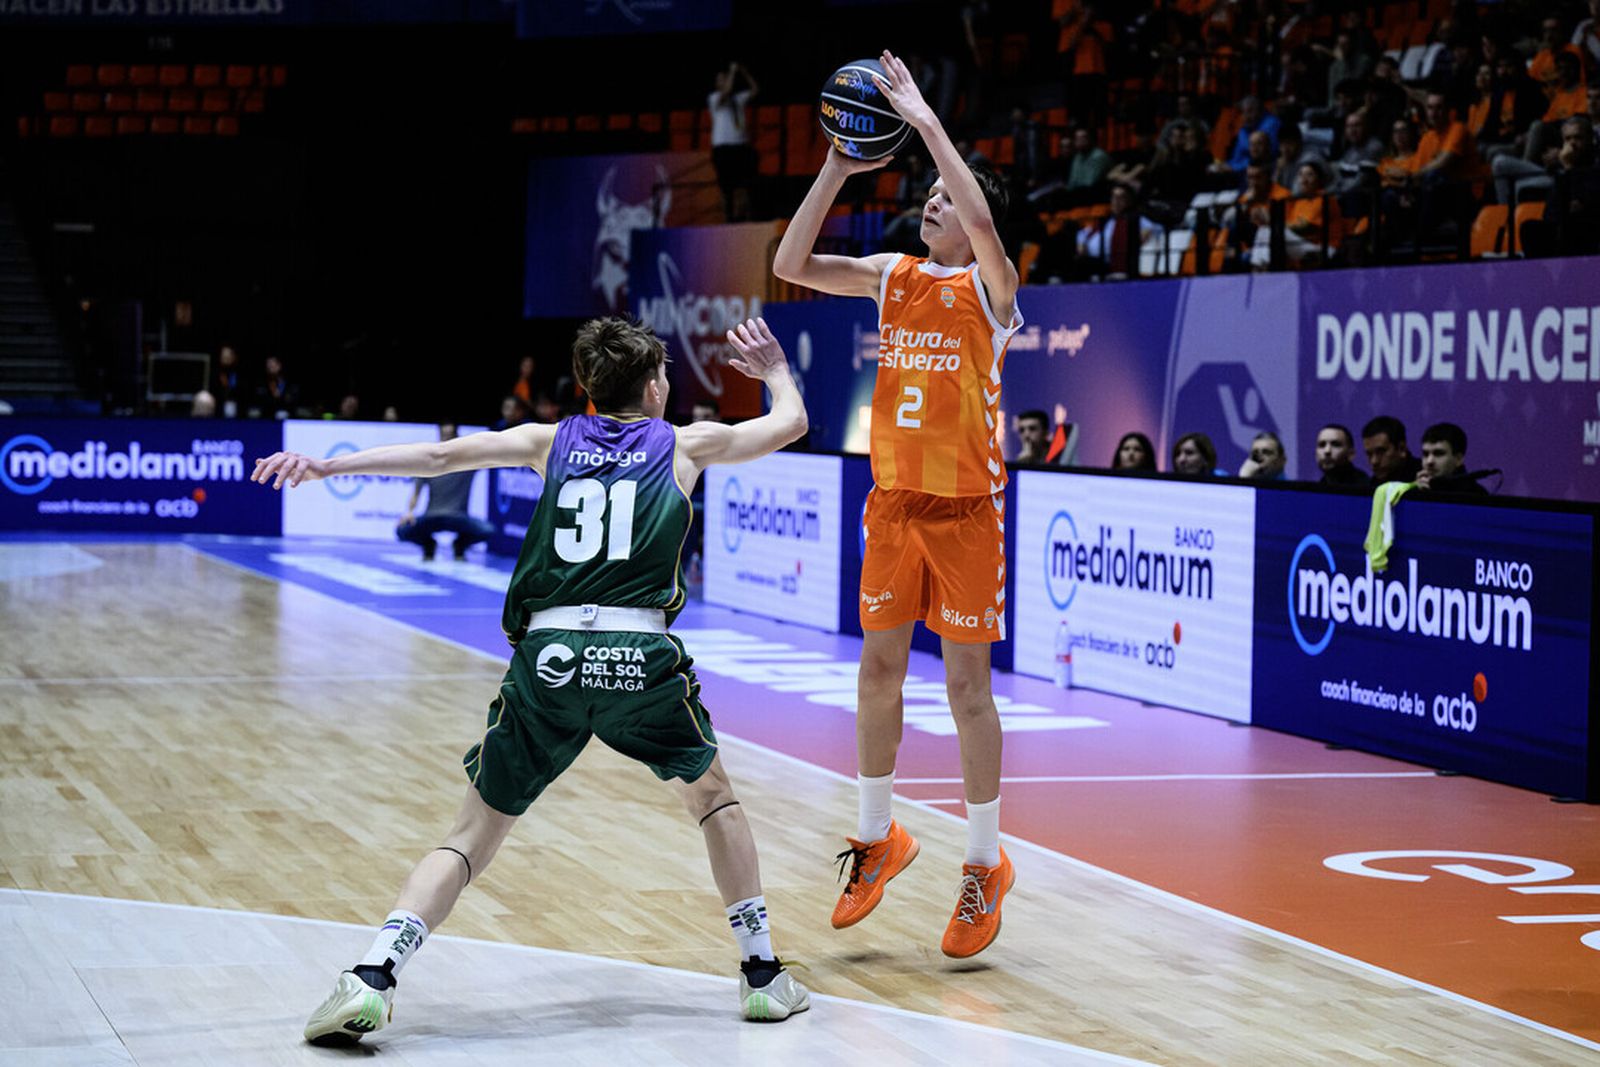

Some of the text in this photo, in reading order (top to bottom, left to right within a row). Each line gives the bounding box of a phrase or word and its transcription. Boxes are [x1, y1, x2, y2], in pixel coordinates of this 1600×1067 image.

[821, 100, 875, 133] Wilson
[880, 323, 961, 349] Cultura del
[1317, 310, 1456, 382] DONDE
[878, 344, 961, 372] Esfuerzo
[896, 385, 923, 428] 2
[10, 440, 244, 482] mediolanum
[155, 497, 198, 518] acb
[553, 477, 638, 564] 31
[725, 488, 820, 541] mediolanum
[1175, 526, 1214, 551] BANCO
[1053, 525, 1213, 600] mediolanum
[1475, 558, 1533, 592] BANCO
[1298, 553, 1532, 651] mediolanum
[581, 662, 647, 678] DEL SOL
[583, 645, 646, 662] COSTA
[1145, 637, 1175, 669] acb
[581, 675, 645, 692] MÁLAGA
[1321, 679, 1425, 716] coach financiero de la
[1433, 692, 1477, 732] acb
